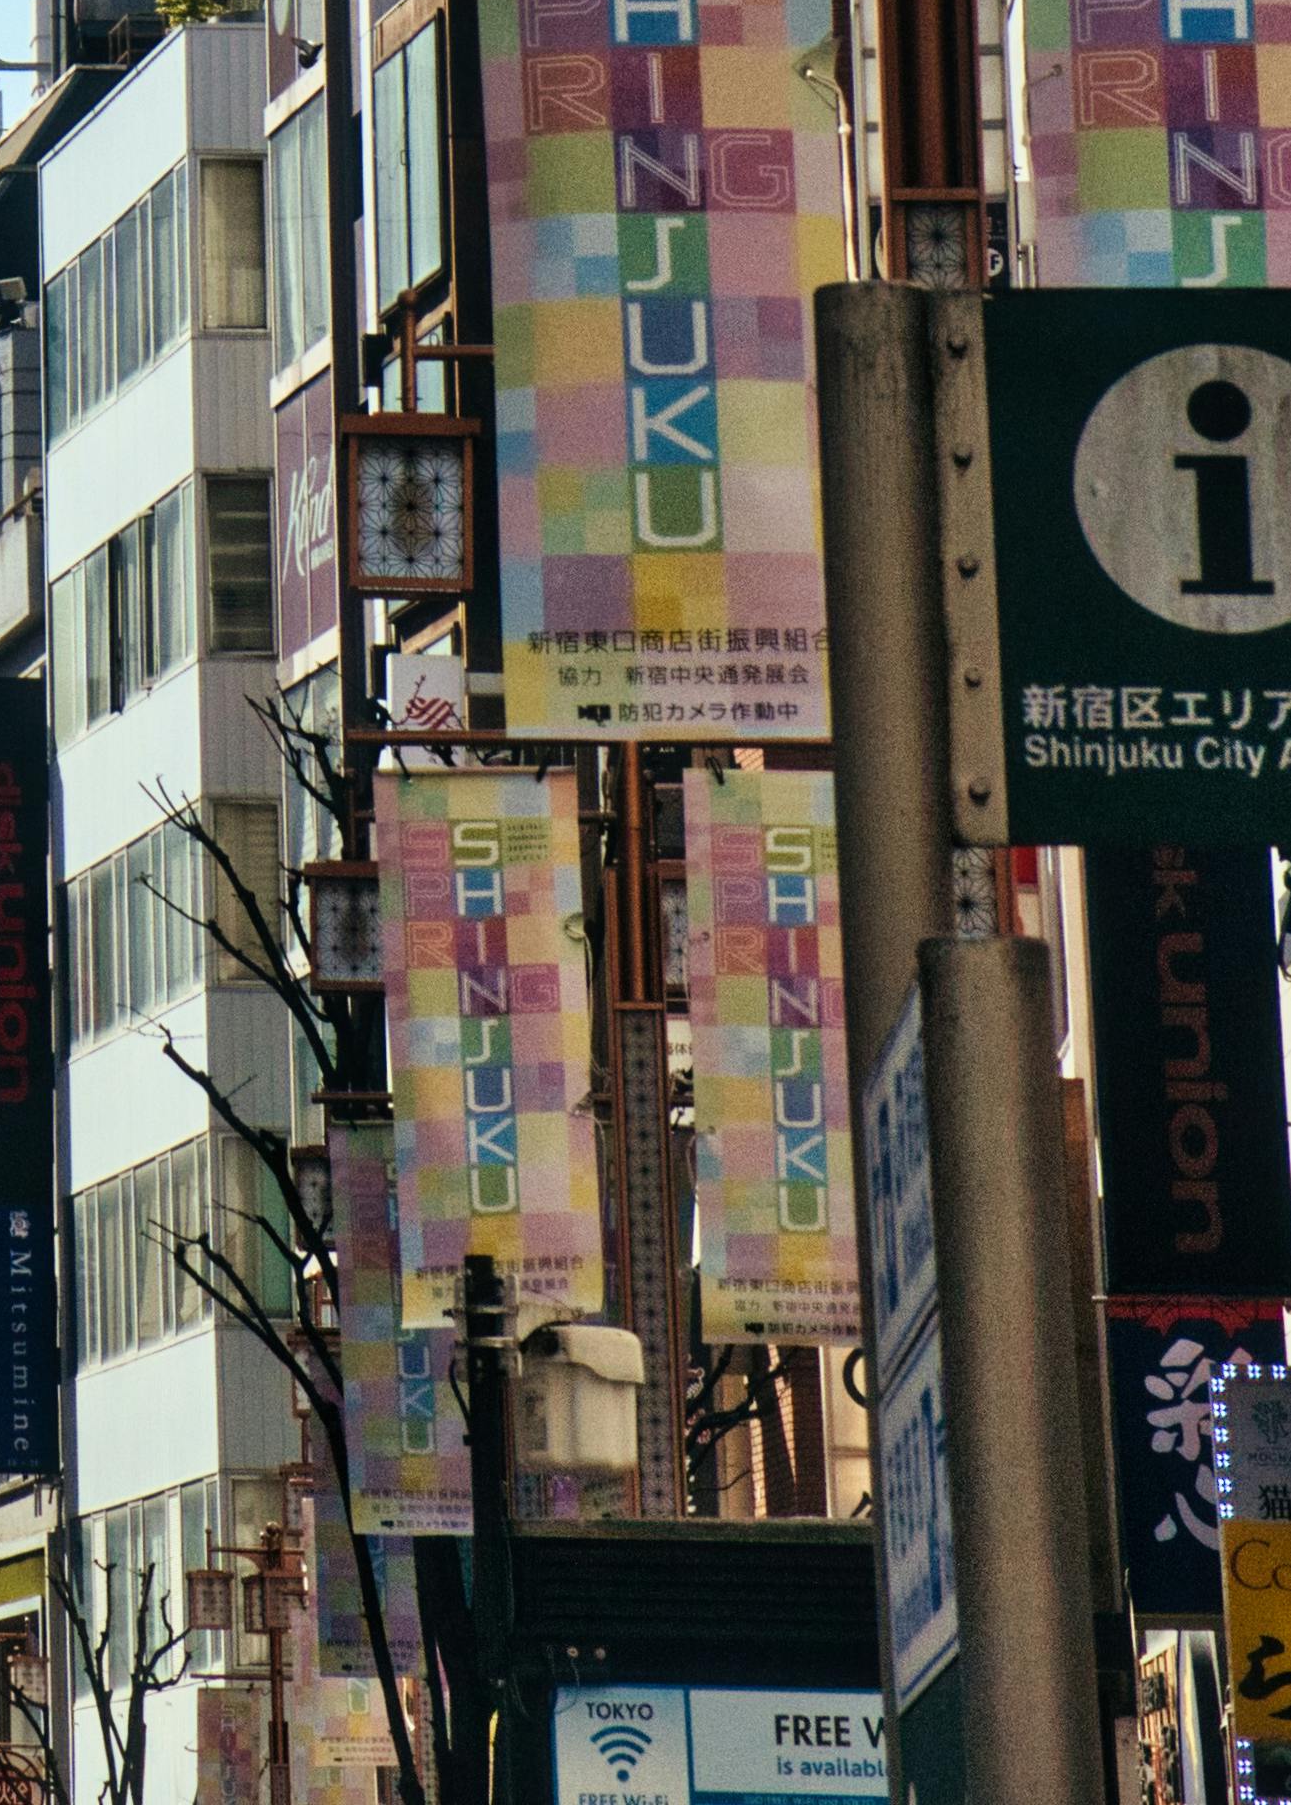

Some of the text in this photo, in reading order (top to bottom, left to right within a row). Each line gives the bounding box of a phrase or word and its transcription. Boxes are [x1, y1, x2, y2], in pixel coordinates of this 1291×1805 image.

[558, 664, 810, 688] 協力 新宿中央通発展会
[619, 702, 799, 722] 防犯カメラ作動中
[1025, 735, 1264, 777] Shinjuku City
[452, 822, 517, 1213] SHINJUKU
[766, 828, 826, 1232] SHINJUKU
[1157, 932, 1229, 1254] union
[10, 1250, 36, 1452] Mitsumine
[586, 1702, 654, 1722] TOKYO
[775, 1715, 851, 1747] FREE
[777, 1758, 793, 1776] is
